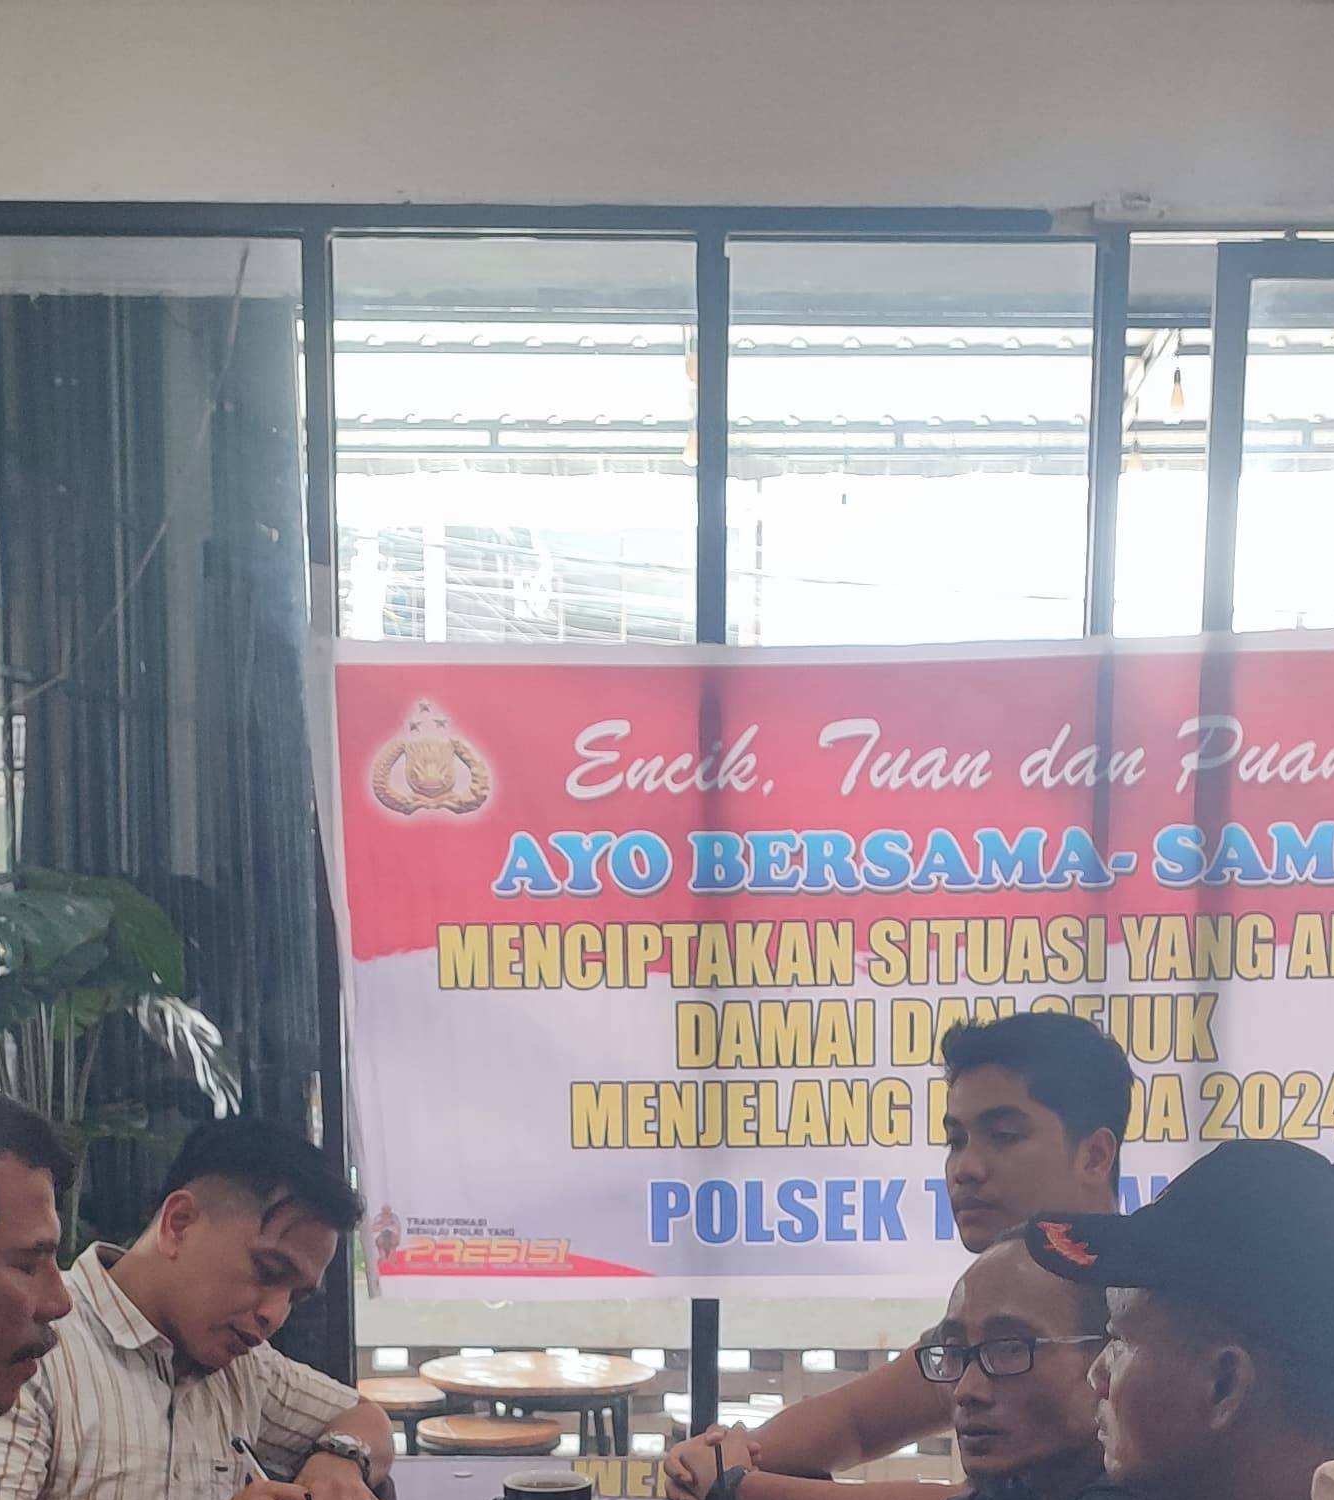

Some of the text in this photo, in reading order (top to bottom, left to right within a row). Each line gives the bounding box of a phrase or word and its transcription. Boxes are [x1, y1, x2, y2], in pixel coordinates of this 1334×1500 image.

[566, 719, 774, 800] Encik,
[818, 717, 993, 796] Tuan
[1020, 724, 1146, 792] dan
[491, 830, 672, 897] AYO
[437, 920, 854, 989] MENCIPTAKAN
[869, 915, 1109, 987] SITUASI
[1121, 911, 1275, 982] YANG
[676, 999, 878, 1069] DAMAI
[571, 1078, 912, 1149] MENJELANG
[406, 1217, 488, 1227] TRANSFORMASI
[406, 1227, 516, 1237] MENUJU POLRI YANG
[647, 1178, 908, 1245] POLSEK
[403, 1237, 571, 1264] PRESISI
